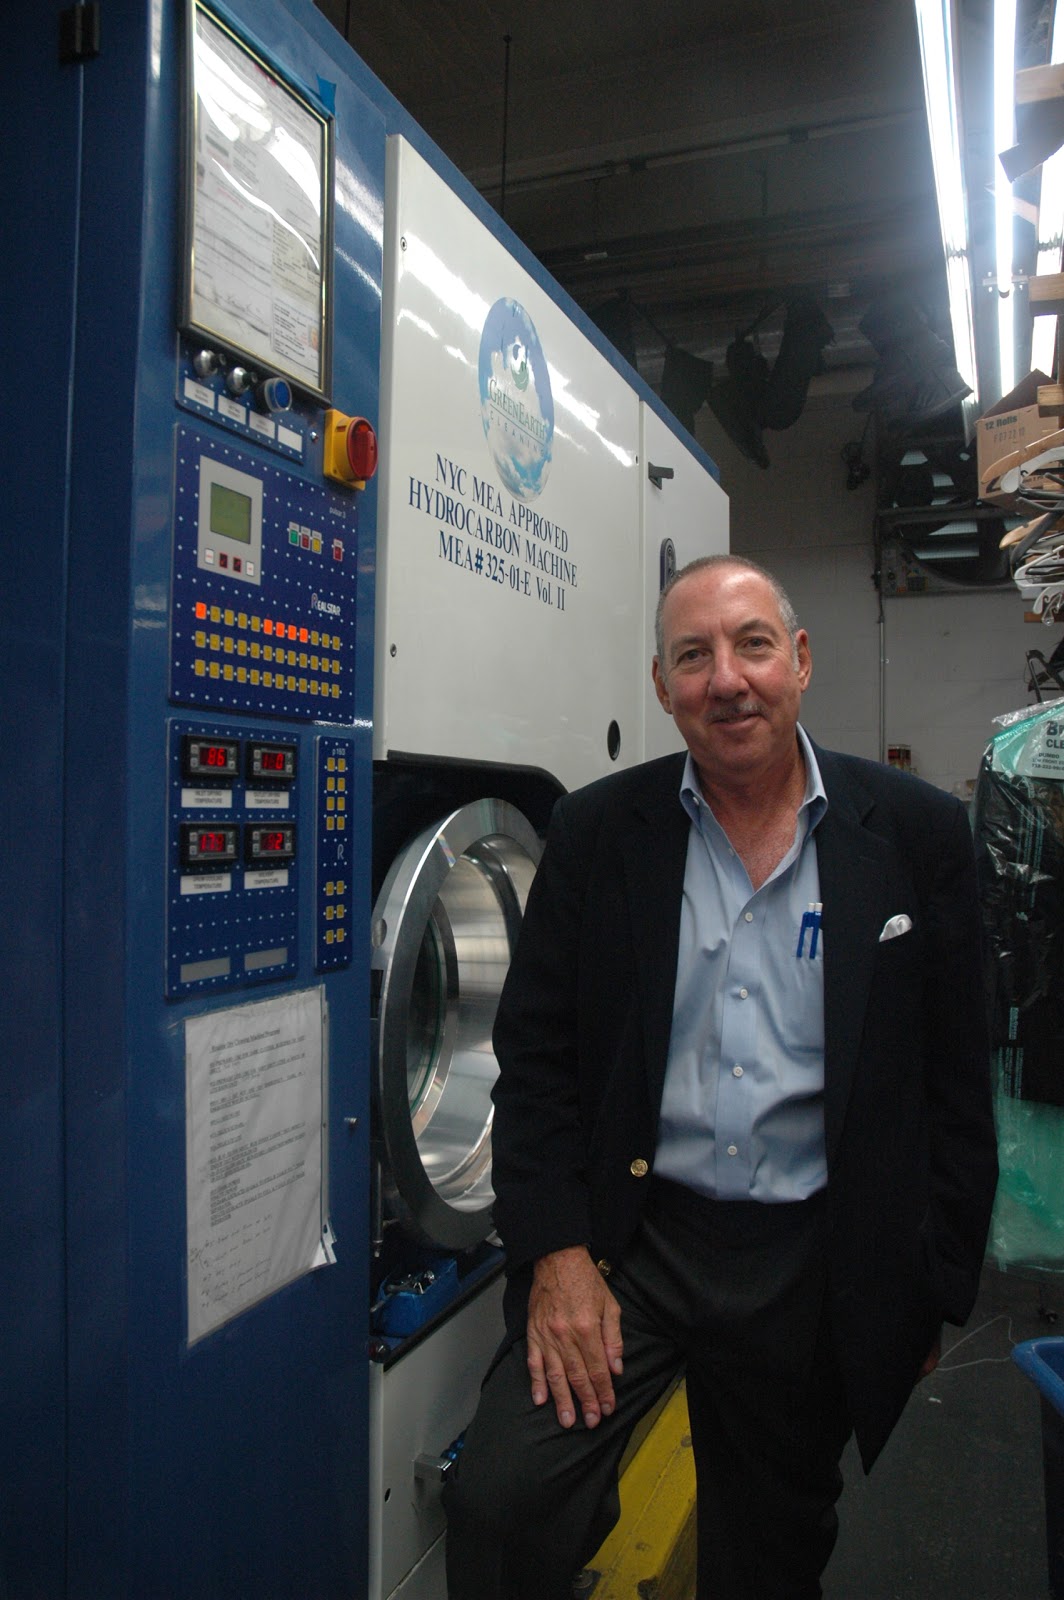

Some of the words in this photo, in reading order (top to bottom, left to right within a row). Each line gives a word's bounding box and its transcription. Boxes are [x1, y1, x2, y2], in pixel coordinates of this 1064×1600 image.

[985, 421, 994, 430] 12
[997, 416, 1017, 428] Rolls
[436, 453, 467, 496] NYC
[472, 475, 504, 518] MEA
[508, 499, 569, 554] APPROVED
[408, 475, 521, 558] HYDROCARBON
[525, 539, 578, 588] MACHINE
[536, 576, 554, 606] Vol.
[557, 585, 566, 611] II
[207, 746, 225, 767] 86
